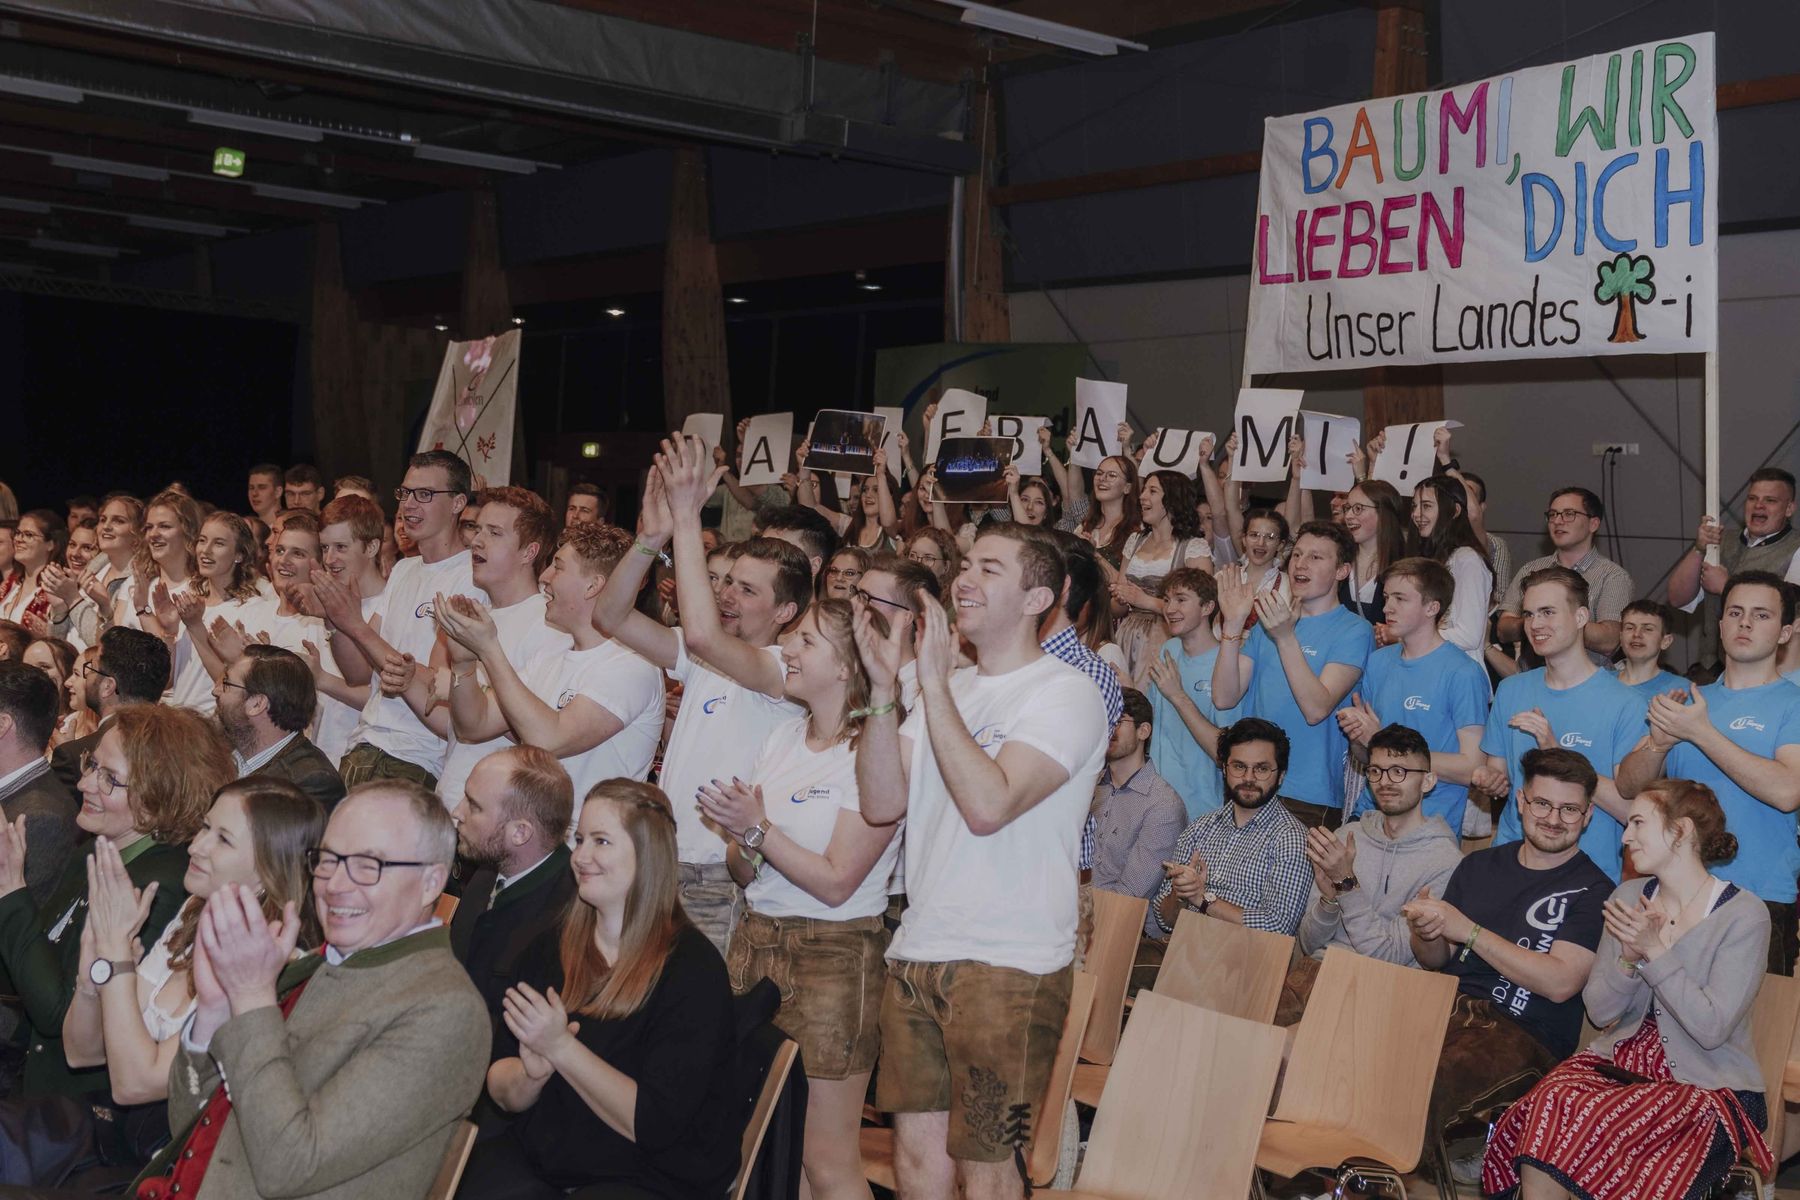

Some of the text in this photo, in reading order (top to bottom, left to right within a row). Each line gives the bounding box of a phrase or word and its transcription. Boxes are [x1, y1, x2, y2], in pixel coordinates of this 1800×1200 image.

[1301, 42, 1696, 195] BAUMI, WIR
[1259, 140, 1704, 285] LIEBEN DICH
[1306, 292, 1416, 361] Unser
[1431, 274, 1581, 353] Landes
[744, 435, 775, 476] A
[1074, 407, 1108, 457] A
[1240, 415, 1294, 468] M
